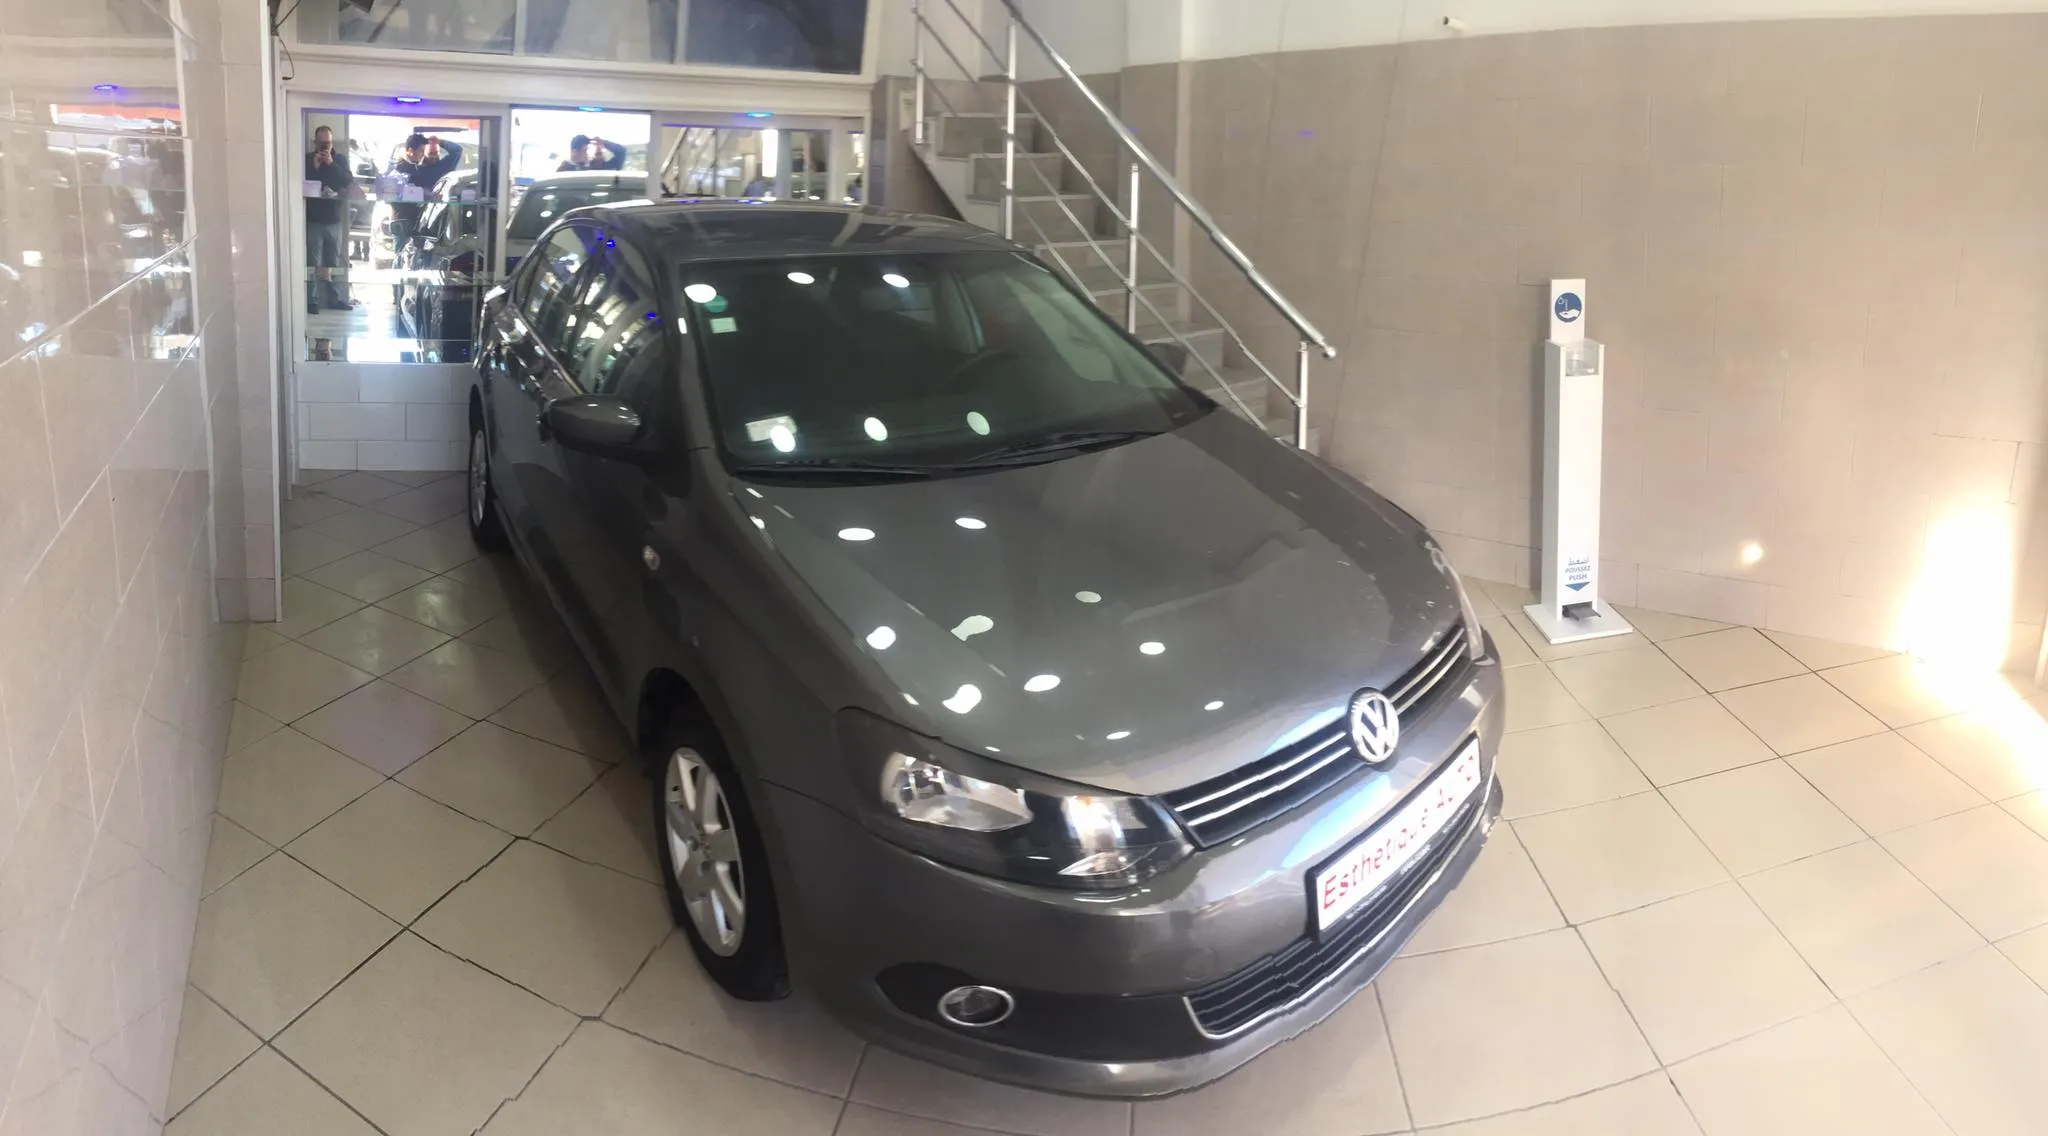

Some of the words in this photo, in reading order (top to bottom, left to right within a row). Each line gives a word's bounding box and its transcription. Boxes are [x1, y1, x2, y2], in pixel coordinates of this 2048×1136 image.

[1565, 565, 1591, 574] POUSSEZ
[1568, 573, 1588, 581] PUSH
[1323, 807, 1429, 911] Esthetie
